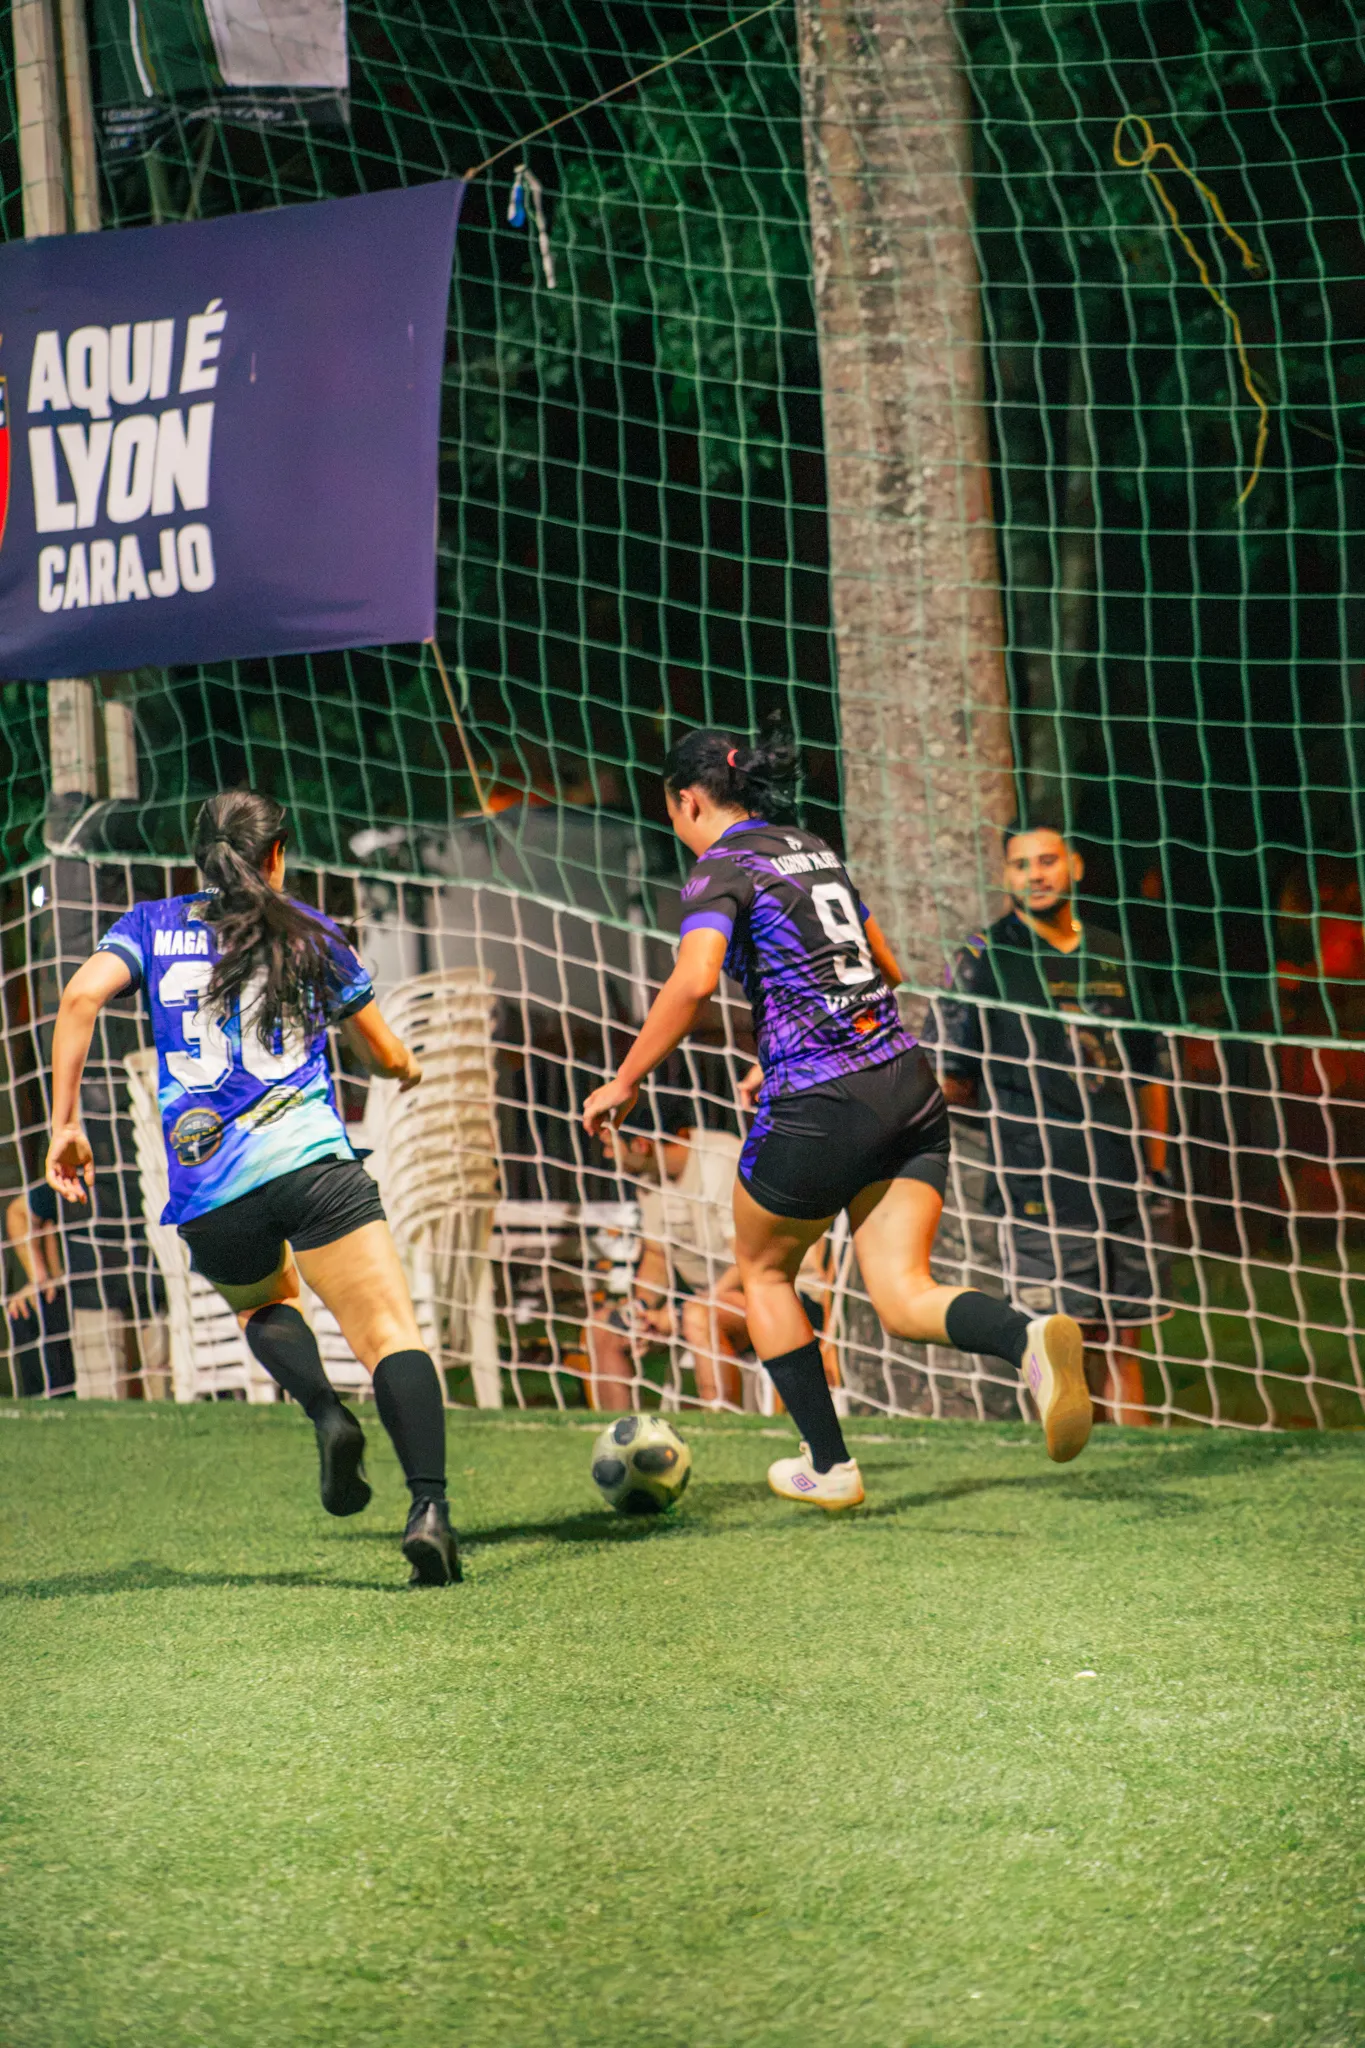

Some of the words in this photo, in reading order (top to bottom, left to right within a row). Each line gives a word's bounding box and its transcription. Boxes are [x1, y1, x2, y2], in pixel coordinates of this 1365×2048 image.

[27, 318, 175, 419] AQUI
[179, 298, 227, 395] É
[28, 401, 215, 534] LYON
[38, 522, 216, 613] CARAJO
[153, 929, 209, 956] MAGA
[811, 882, 875, 985] 9
[158, 960, 310, 1094] 30
